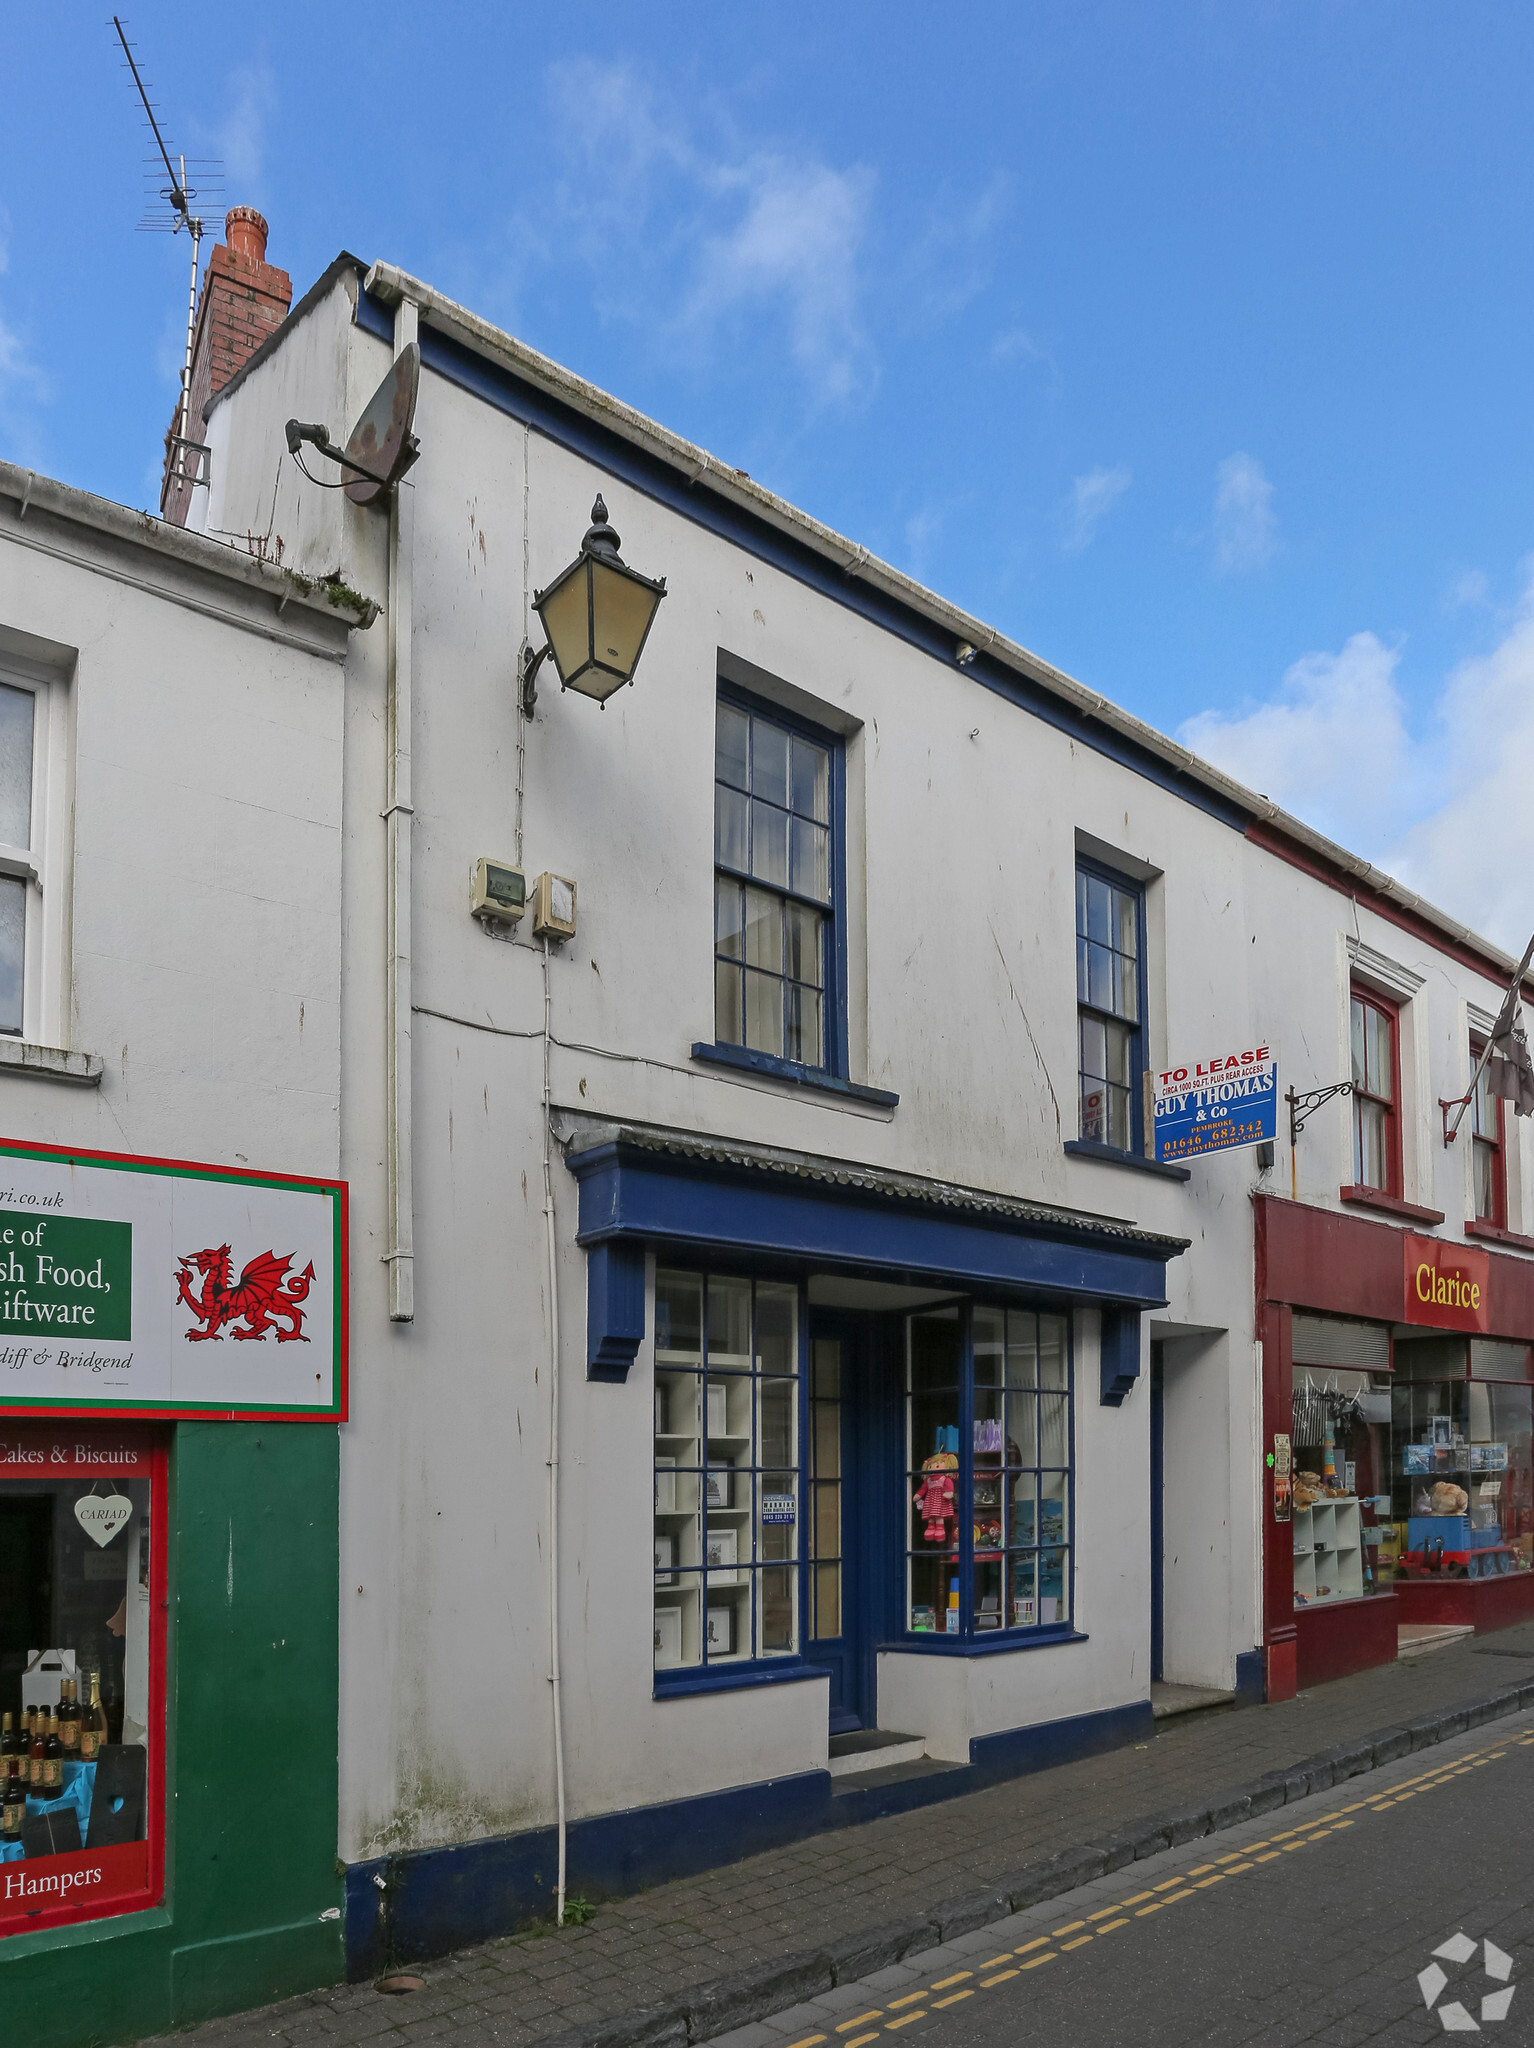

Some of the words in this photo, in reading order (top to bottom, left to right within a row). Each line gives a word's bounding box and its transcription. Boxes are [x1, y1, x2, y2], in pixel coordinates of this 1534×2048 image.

[1159, 1068, 1188, 1085] TO
[1196, 1046, 1270, 1076] LEASE
[1162, 1085, 1178, 1096] CIRCA
[1179, 1081, 1192, 1091] 1000
[1210, 1073, 1224, 1084] PLUS
[1226, 1070, 1240, 1080] REAR
[1241, 1064, 1264, 1076] ACCESS
[1154, 1093, 1189, 1118] GUY
[1193, 1073, 1274, 1108] THOMAS
[1191, 1119, 1233, 1134] PEMBROKE
[1195, 1109, 1207, 1122] &
[1210, 1106, 1228, 1118] Co
[1162, 1130, 1264, 1158] www.guythomas.com
[1164, 1134, 1202, 1151] 01646
[1211, 1120, 1262, 1141] 682342
[0, 1228, 14, 1244] e
[21, 1222, 47, 1247] of
[36, 1254, 110, 1293] Food,
[1416, 1262, 1481, 1310] Clarice
[0, 1289, 95, 1325] iftware
[33, 1347, 52, 1365] &
[56, 1350, 133, 1373] Bridgend
[50, 1444, 68, 1464] &
[74, 1444, 138, 1464] Biscuits
[80, 1509, 127, 1520] CARIAD
[4, 1867, 102, 1899] Hampers
